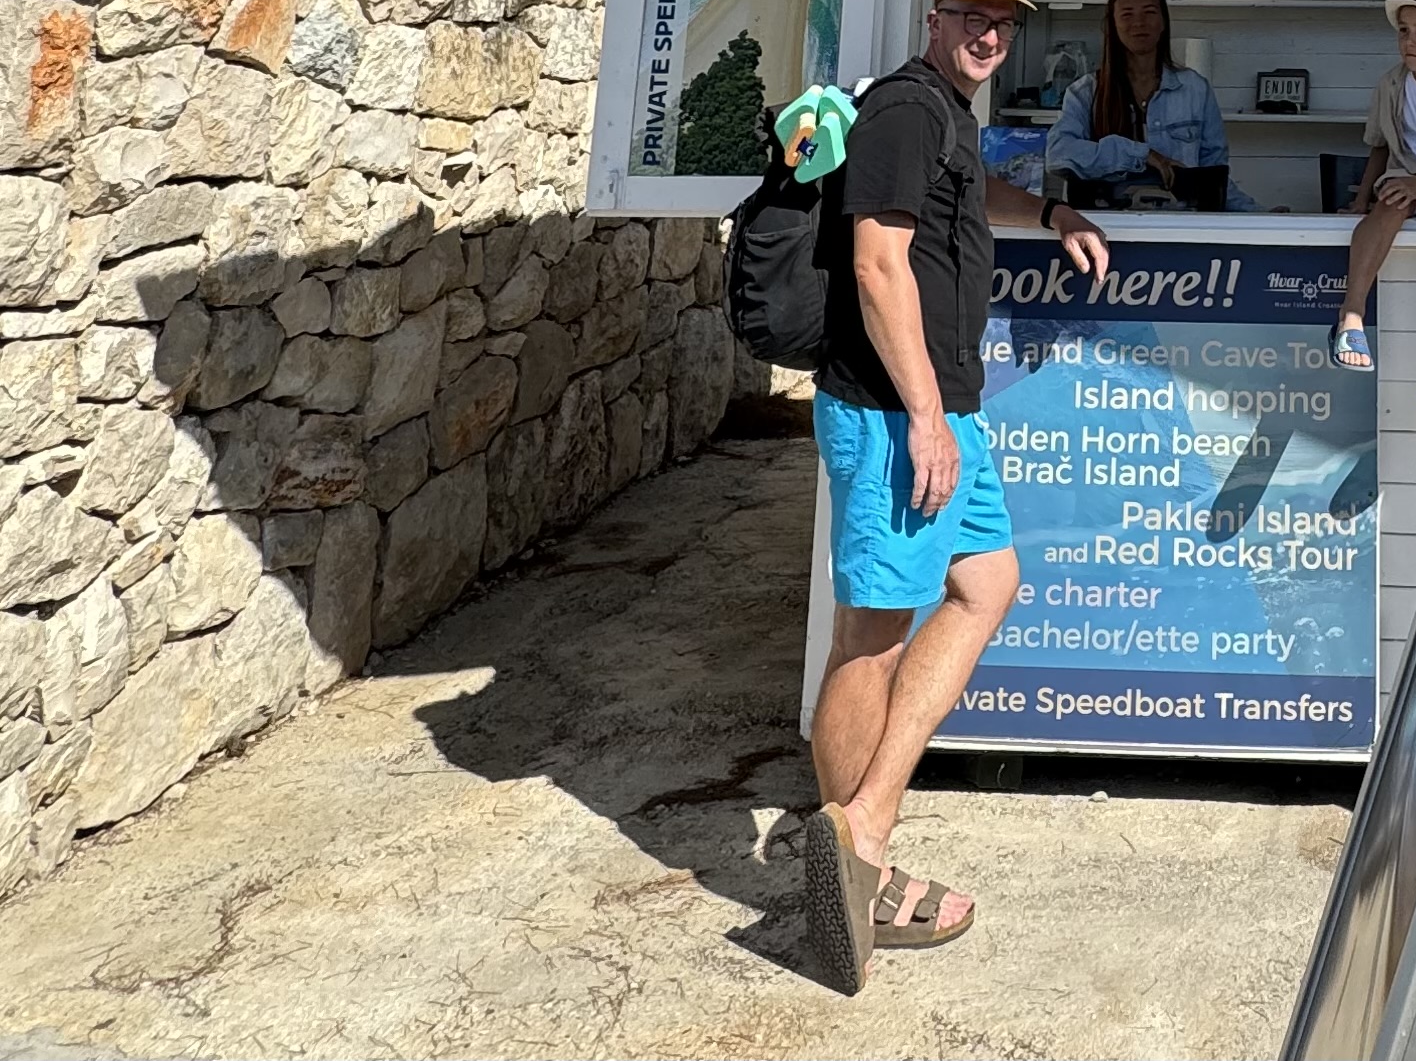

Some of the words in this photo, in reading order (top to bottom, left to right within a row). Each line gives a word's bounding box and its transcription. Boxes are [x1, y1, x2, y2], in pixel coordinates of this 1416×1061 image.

[1265, 80, 1300, 94] ENJOY
[643, 59, 670, 167] PRIVATE
[989, 258, 1074, 304] ook
[1267, 273, 1303, 288] Hvar
[1317, 273, 1348, 289] Crui
[1318, 301, 1342, 309] Croati
[980, 340, 1012, 362] ue
[1023, 337, 1082, 365] and
[1094, 338, 1190, 367] Green
[1201, 340, 1278, 368] Cave
[1287, 342, 1337, 369] To
[1074, 380, 1174, 411] Island
[1187, 381, 1331, 421] hopping
[987, 422, 1070, 452] olden
[1081, 425, 1160, 454] Horn
[1172, 426, 1271, 457] beach
[1003, 455, 1073, 485] Brač
[1084, 456, 1181, 487] Island
[1122, 500, 1245, 533] Pakleni
[1044, 542, 1088, 564] and
[1095, 535, 1159, 566] Red
[1172, 536, 1273, 571] Rocks
[1284, 540, 1359, 571] Tour
[1045, 578, 1162, 609] charter
[1211, 628, 1296, 663] party
[954, 687, 1026, 712] vate
[1035, 686, 1206, 721] Speedboat
[1213, 691, 1353, 723] Transfers
